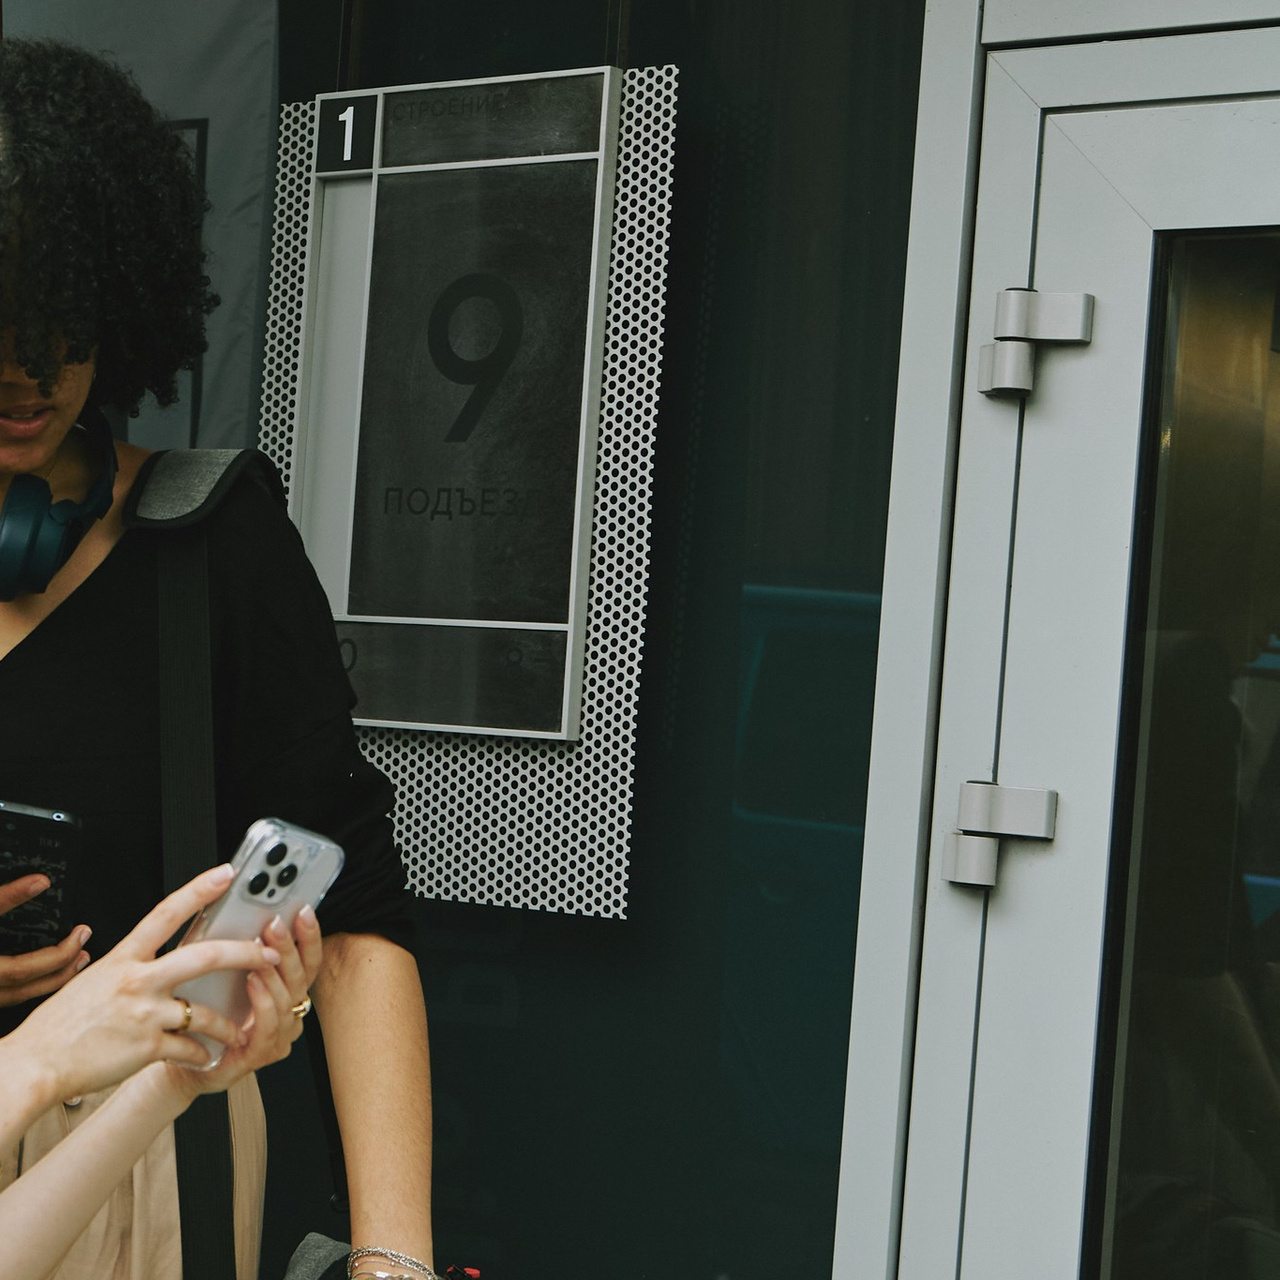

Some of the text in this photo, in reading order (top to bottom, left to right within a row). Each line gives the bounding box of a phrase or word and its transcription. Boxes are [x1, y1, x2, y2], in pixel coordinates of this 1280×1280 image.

[337, 105, 355, 162] 1
[392, 93, 504, 122] СТРОЕНИЕ
[427, 272, 523, 443] 9
